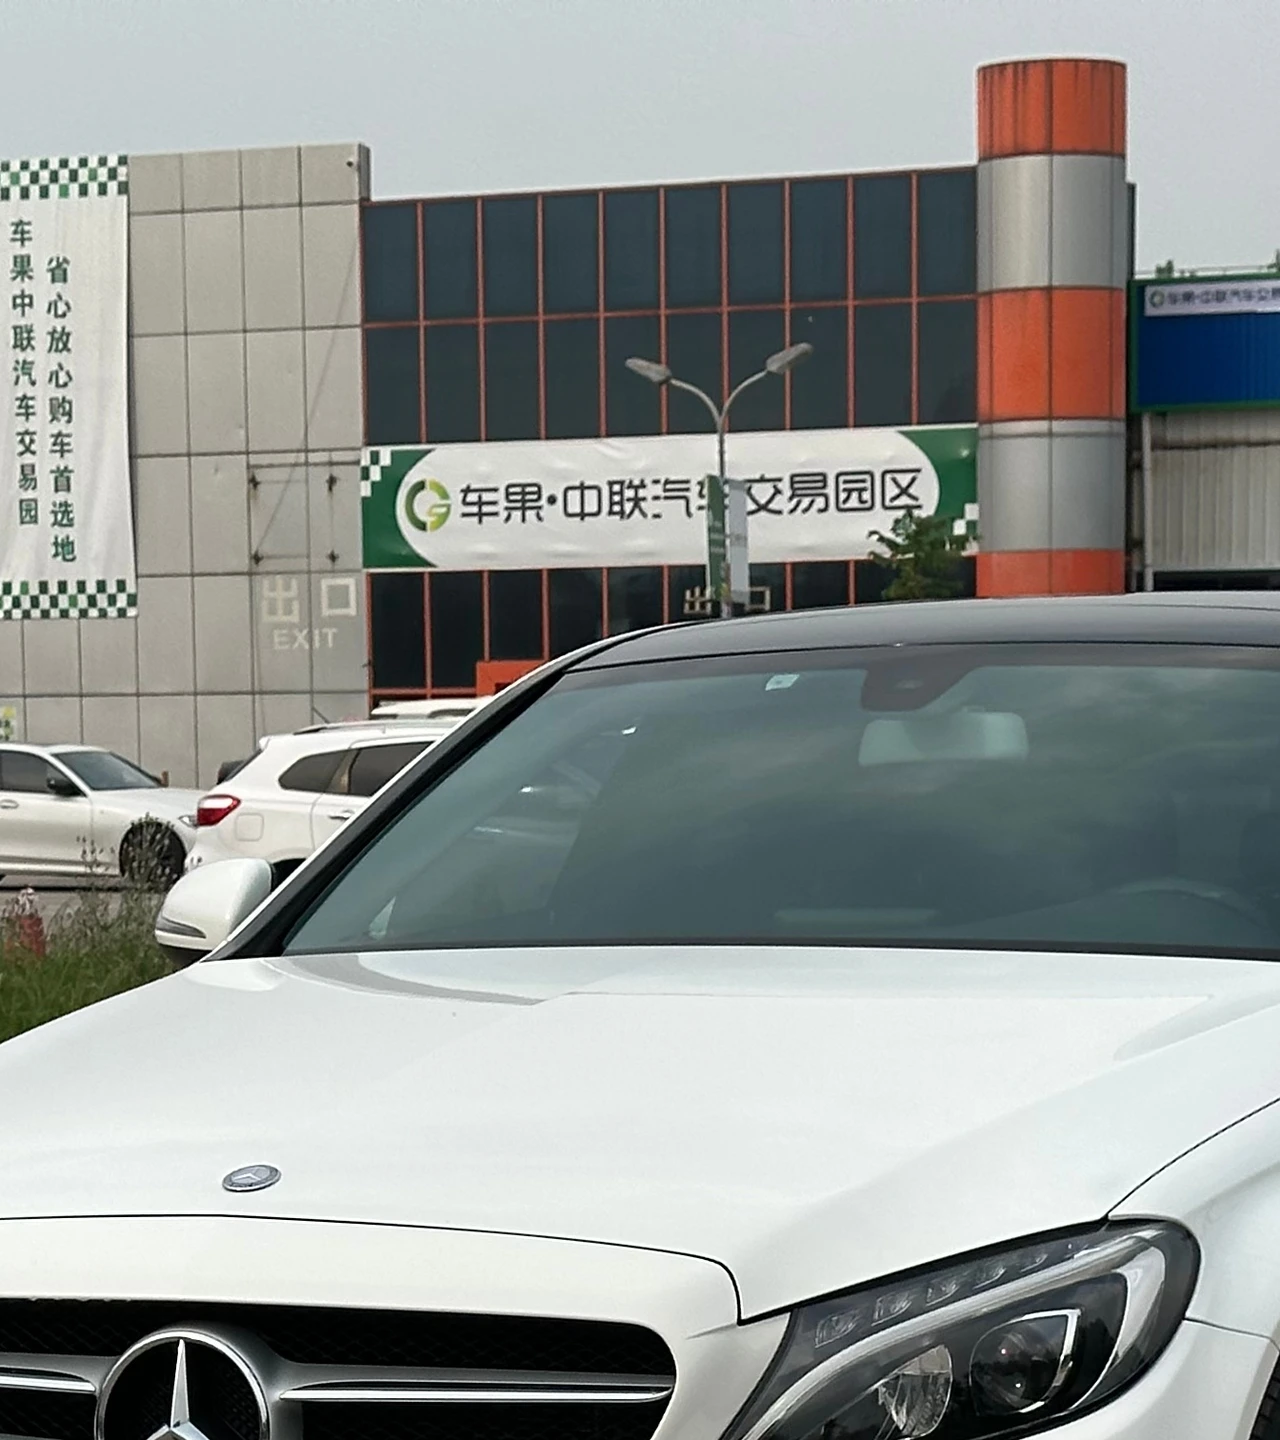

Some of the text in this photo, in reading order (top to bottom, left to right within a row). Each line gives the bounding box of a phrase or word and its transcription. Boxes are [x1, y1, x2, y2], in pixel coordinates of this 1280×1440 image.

[9, 219, 39, 526] 车果中联汽车交易园
[46, 255, 77, 563] 省心放心购车首选地
[261, 576, 357, 623] 出口
[273, 628, 338, 650] EXIT
